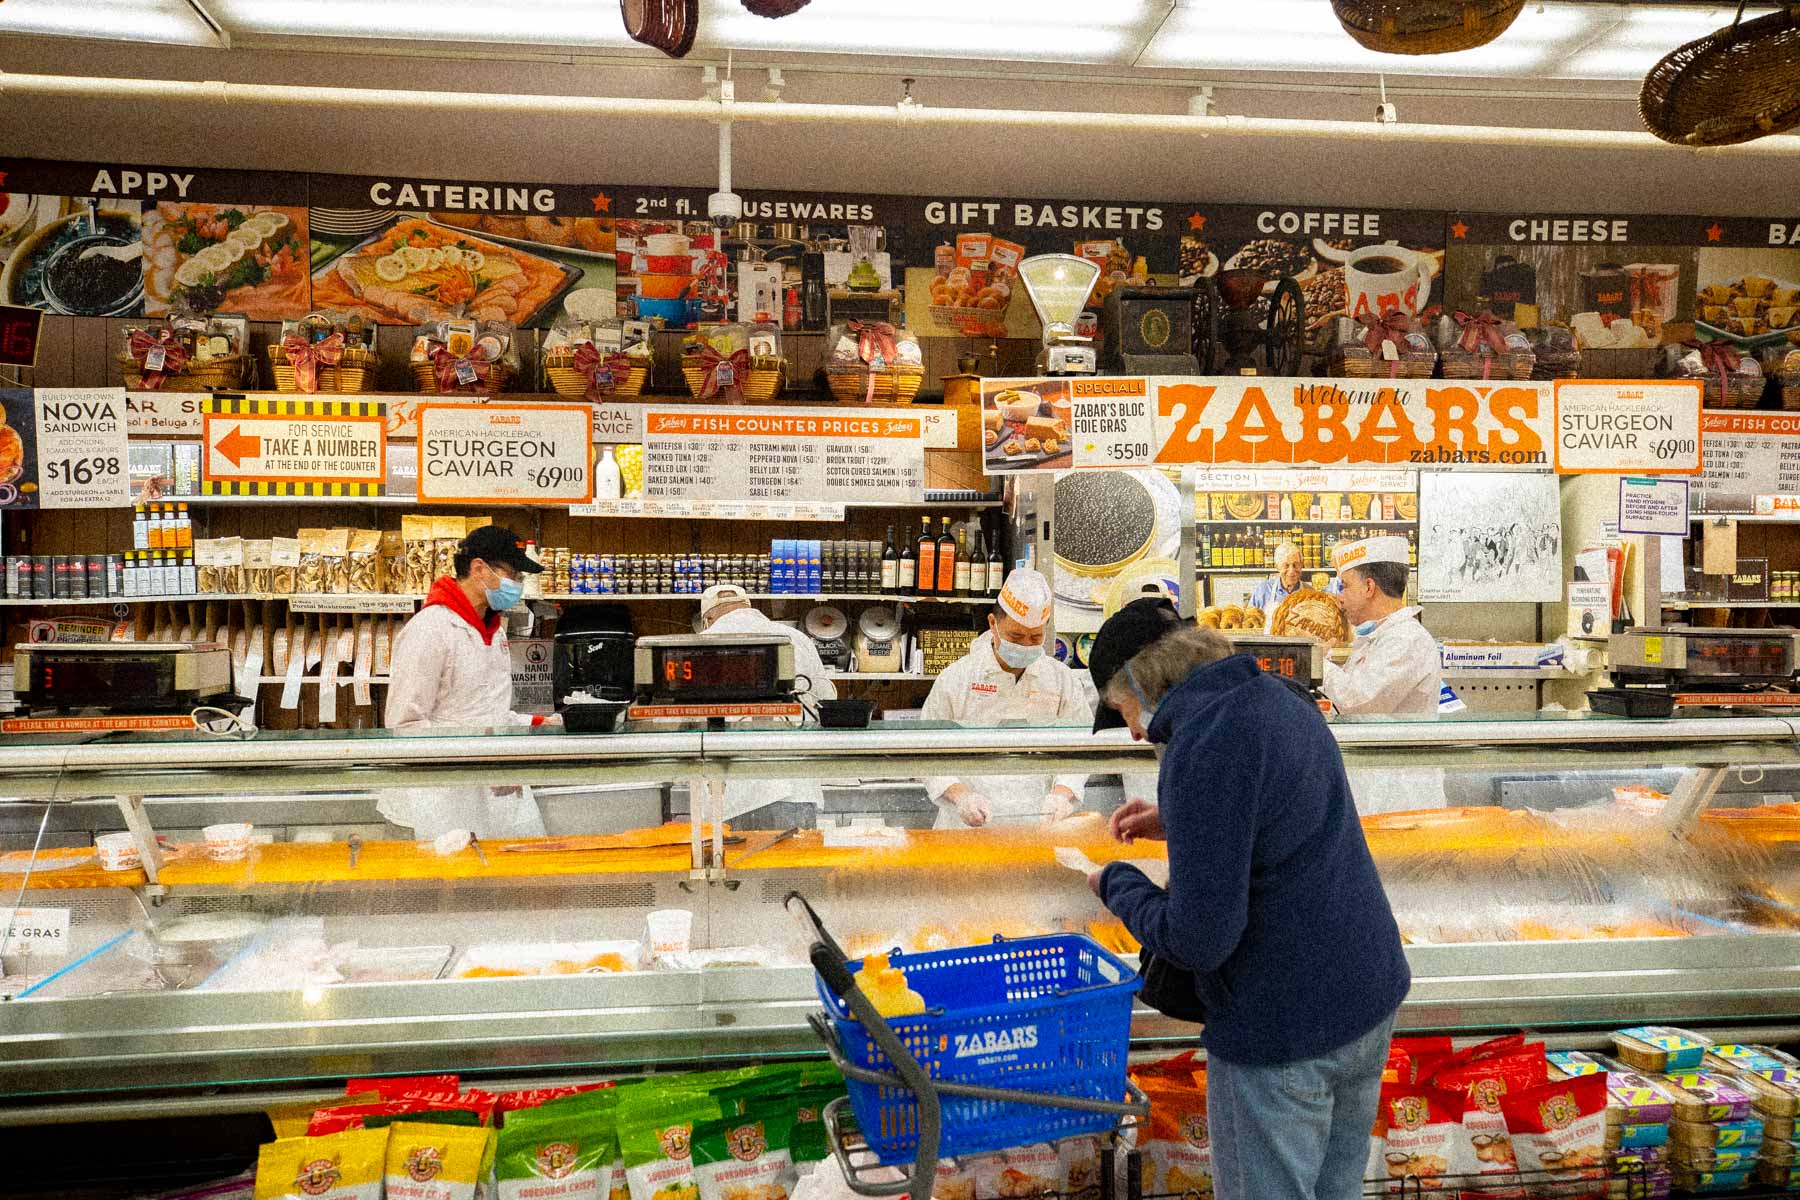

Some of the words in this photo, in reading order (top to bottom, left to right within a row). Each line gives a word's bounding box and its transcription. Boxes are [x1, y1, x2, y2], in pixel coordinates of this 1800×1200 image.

[90, 169, 195, 197] APPY
[369, 182, 555, 212] CATERING
[635, 197, 667, 214] 2nd
[676, 198, 698, 215] fl.
[743, 201, 874, 220] USEWARES
[924, 202, 1000, 225] GIFT
[1014, 204, 1164, 230] BASKETS
[1256, 211, 1380, 236] COFFEE
[1508, 220, 1628, 242] CHEESE
[1076, 382, 1142, 394] SPECIAL!
[1300, 384, 1386, 406] Welcome
[1393, 388, 1412, 406] to
[43, 402, 117, 421] NOVA
[592, 410, 632, 420] ECIAL
[1074, 403, 1116, 417] ZABAR'S
[1119, 403, 1145, 416] BLOC
[44, 422, 116, 432] SANDWICH
[152, 417, 187, 429] Beluga
[593, 423, 632, 433] RVICE
[693, 418, 730, 430] FISH
[736, 419, 816, 432] COUNTER
[822, 421, 879, 433] PRICES
[1075, 420, 1098, 433] FOIE
[1100, 419, 1127, 432] GRAS
[1152, 384, 1542, 464] ZABAR'S
[1562, 414, 1672, 430] STURGEON
[1733, 418, 1766, 430] FISH
[288, 424, 308, 436] FOR
[312, 424, 353, 438] SERVICE
[428, 430, 478, 438] AMERICAN
[480, 430, 543, 438] HACKLEBACK
[648, 442, 682, 450] WHITEFISH
[1563, 434, 1638, 449] CAVIAR
[264, 438, 299, 456] TAKE
[303, 440, 312, 456] A
[317, 440, 377, 458] NUMBER
[427, 440, 556, 458] STURGEON
[750, 444, 780, 452] PASTRAMI
[781, 444, 796, 452] NOVA
[750, 455, 780, 463] PEPPERED
[1410, 445, 1548, 464] zabars.com
[265, 460, 276, 470] AT
[277, 460, 292, 470] THE
[294, 460, 309, 470] END
[312, 461, 321, 470] OF
[324, 462, 338, 470] THE
[340, 462, 376, 472] COUNTER
[428, 460, 514, 478] CAVIAR
[648, 465, 673, 473] PICKLED
[676, 465, 687, 473] LOX
[826, 467, 849, 475] SCOTCH
[872, 468, 895, 476] SALMON
[750, 478, 781, 486] STURGEON
[648, 488, 664, 496] NOVA
[57, 624, 104, 634] REMINDER
[588, 642, 603, 654] Scott
[1446, 653, 1485, 661] Aluminum
[524, 664, 548, 672] HAND
[512, 673, 538, 682] WASH
[22, 928, 60, 938] GRAS
[954, 1025, 1038, 1058] ZABARS
